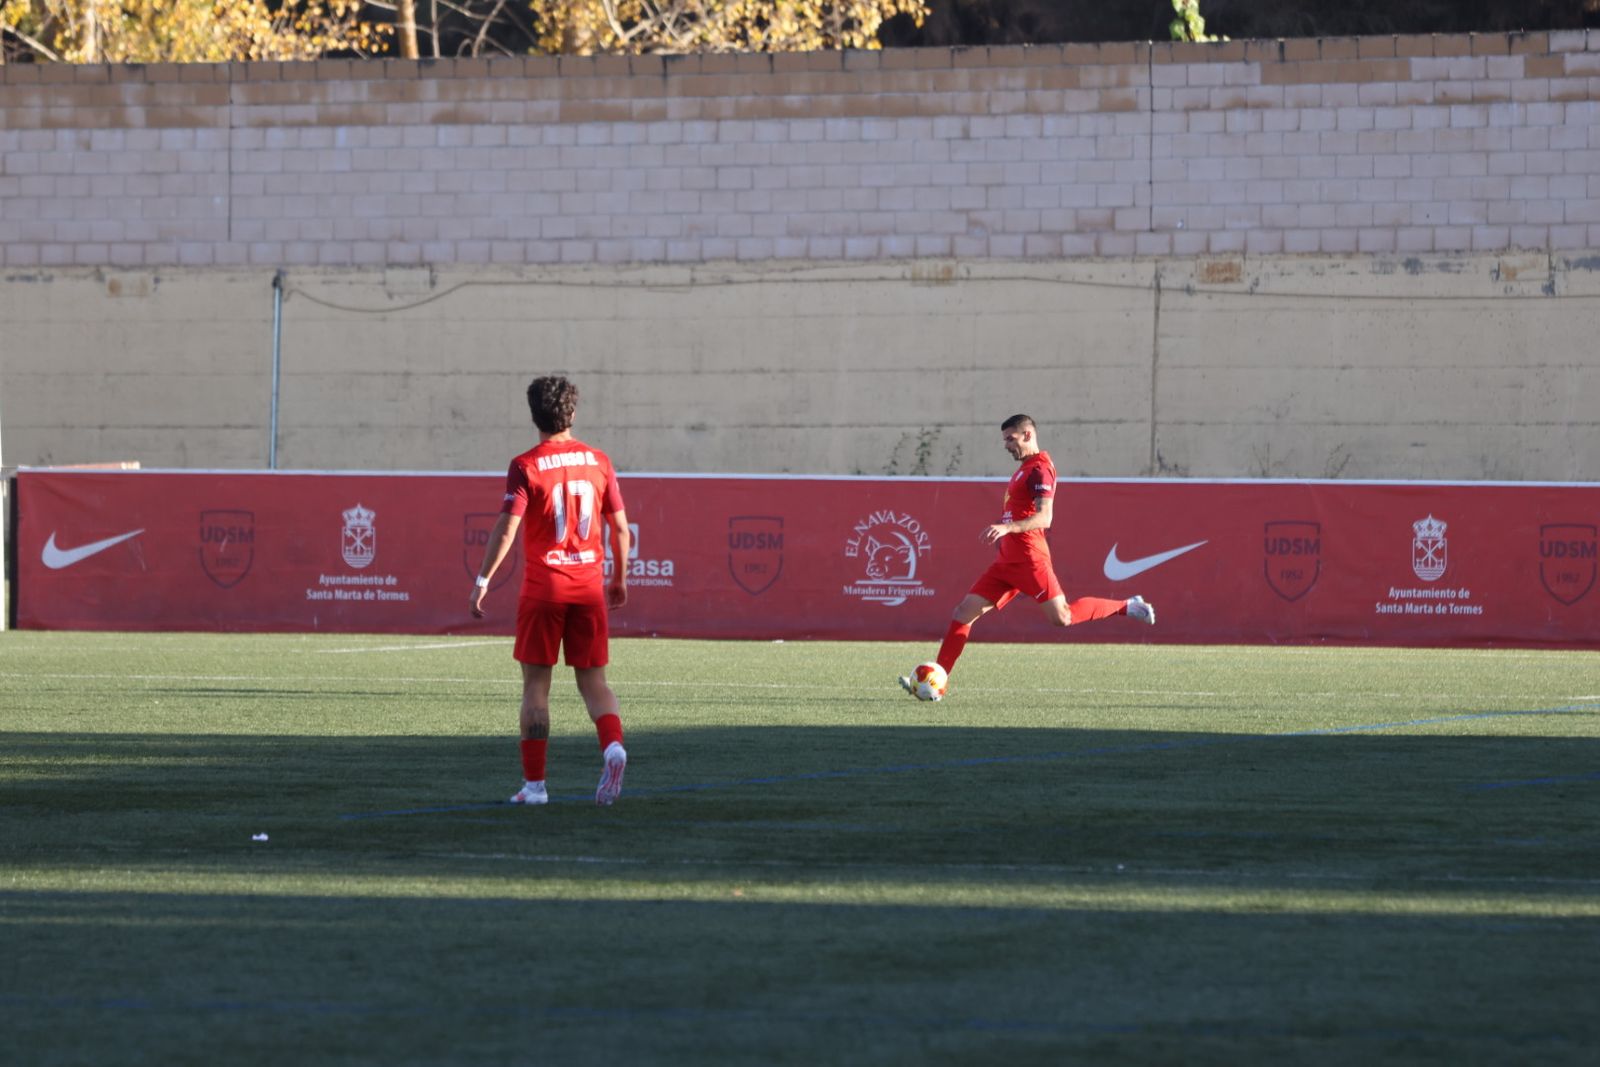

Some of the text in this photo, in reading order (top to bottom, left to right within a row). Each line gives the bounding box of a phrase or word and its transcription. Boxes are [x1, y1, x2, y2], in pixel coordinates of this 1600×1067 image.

[552, 480, 594, 544] 17
[200, 526, 254, 544] UDSM
[728, 532, 784, 550] UDSM
[845, 538, 861, 557] EL
[854, 510, 920, 536] NAVAZO
[1264, 537, 1320, 555] UDSM
[1539, 541, 1597, 558] UDSM
[319, 574, 397, 586] Ayuntamiento de
[306, 588, 409, 600] Santa Marta de Tormes
[843, 585, 887, 596] Matadero
[1389, 587, 1470, 600] Ayuntamiento de
[1375, 602, 1483, 614] Santa Marta de Tormes
